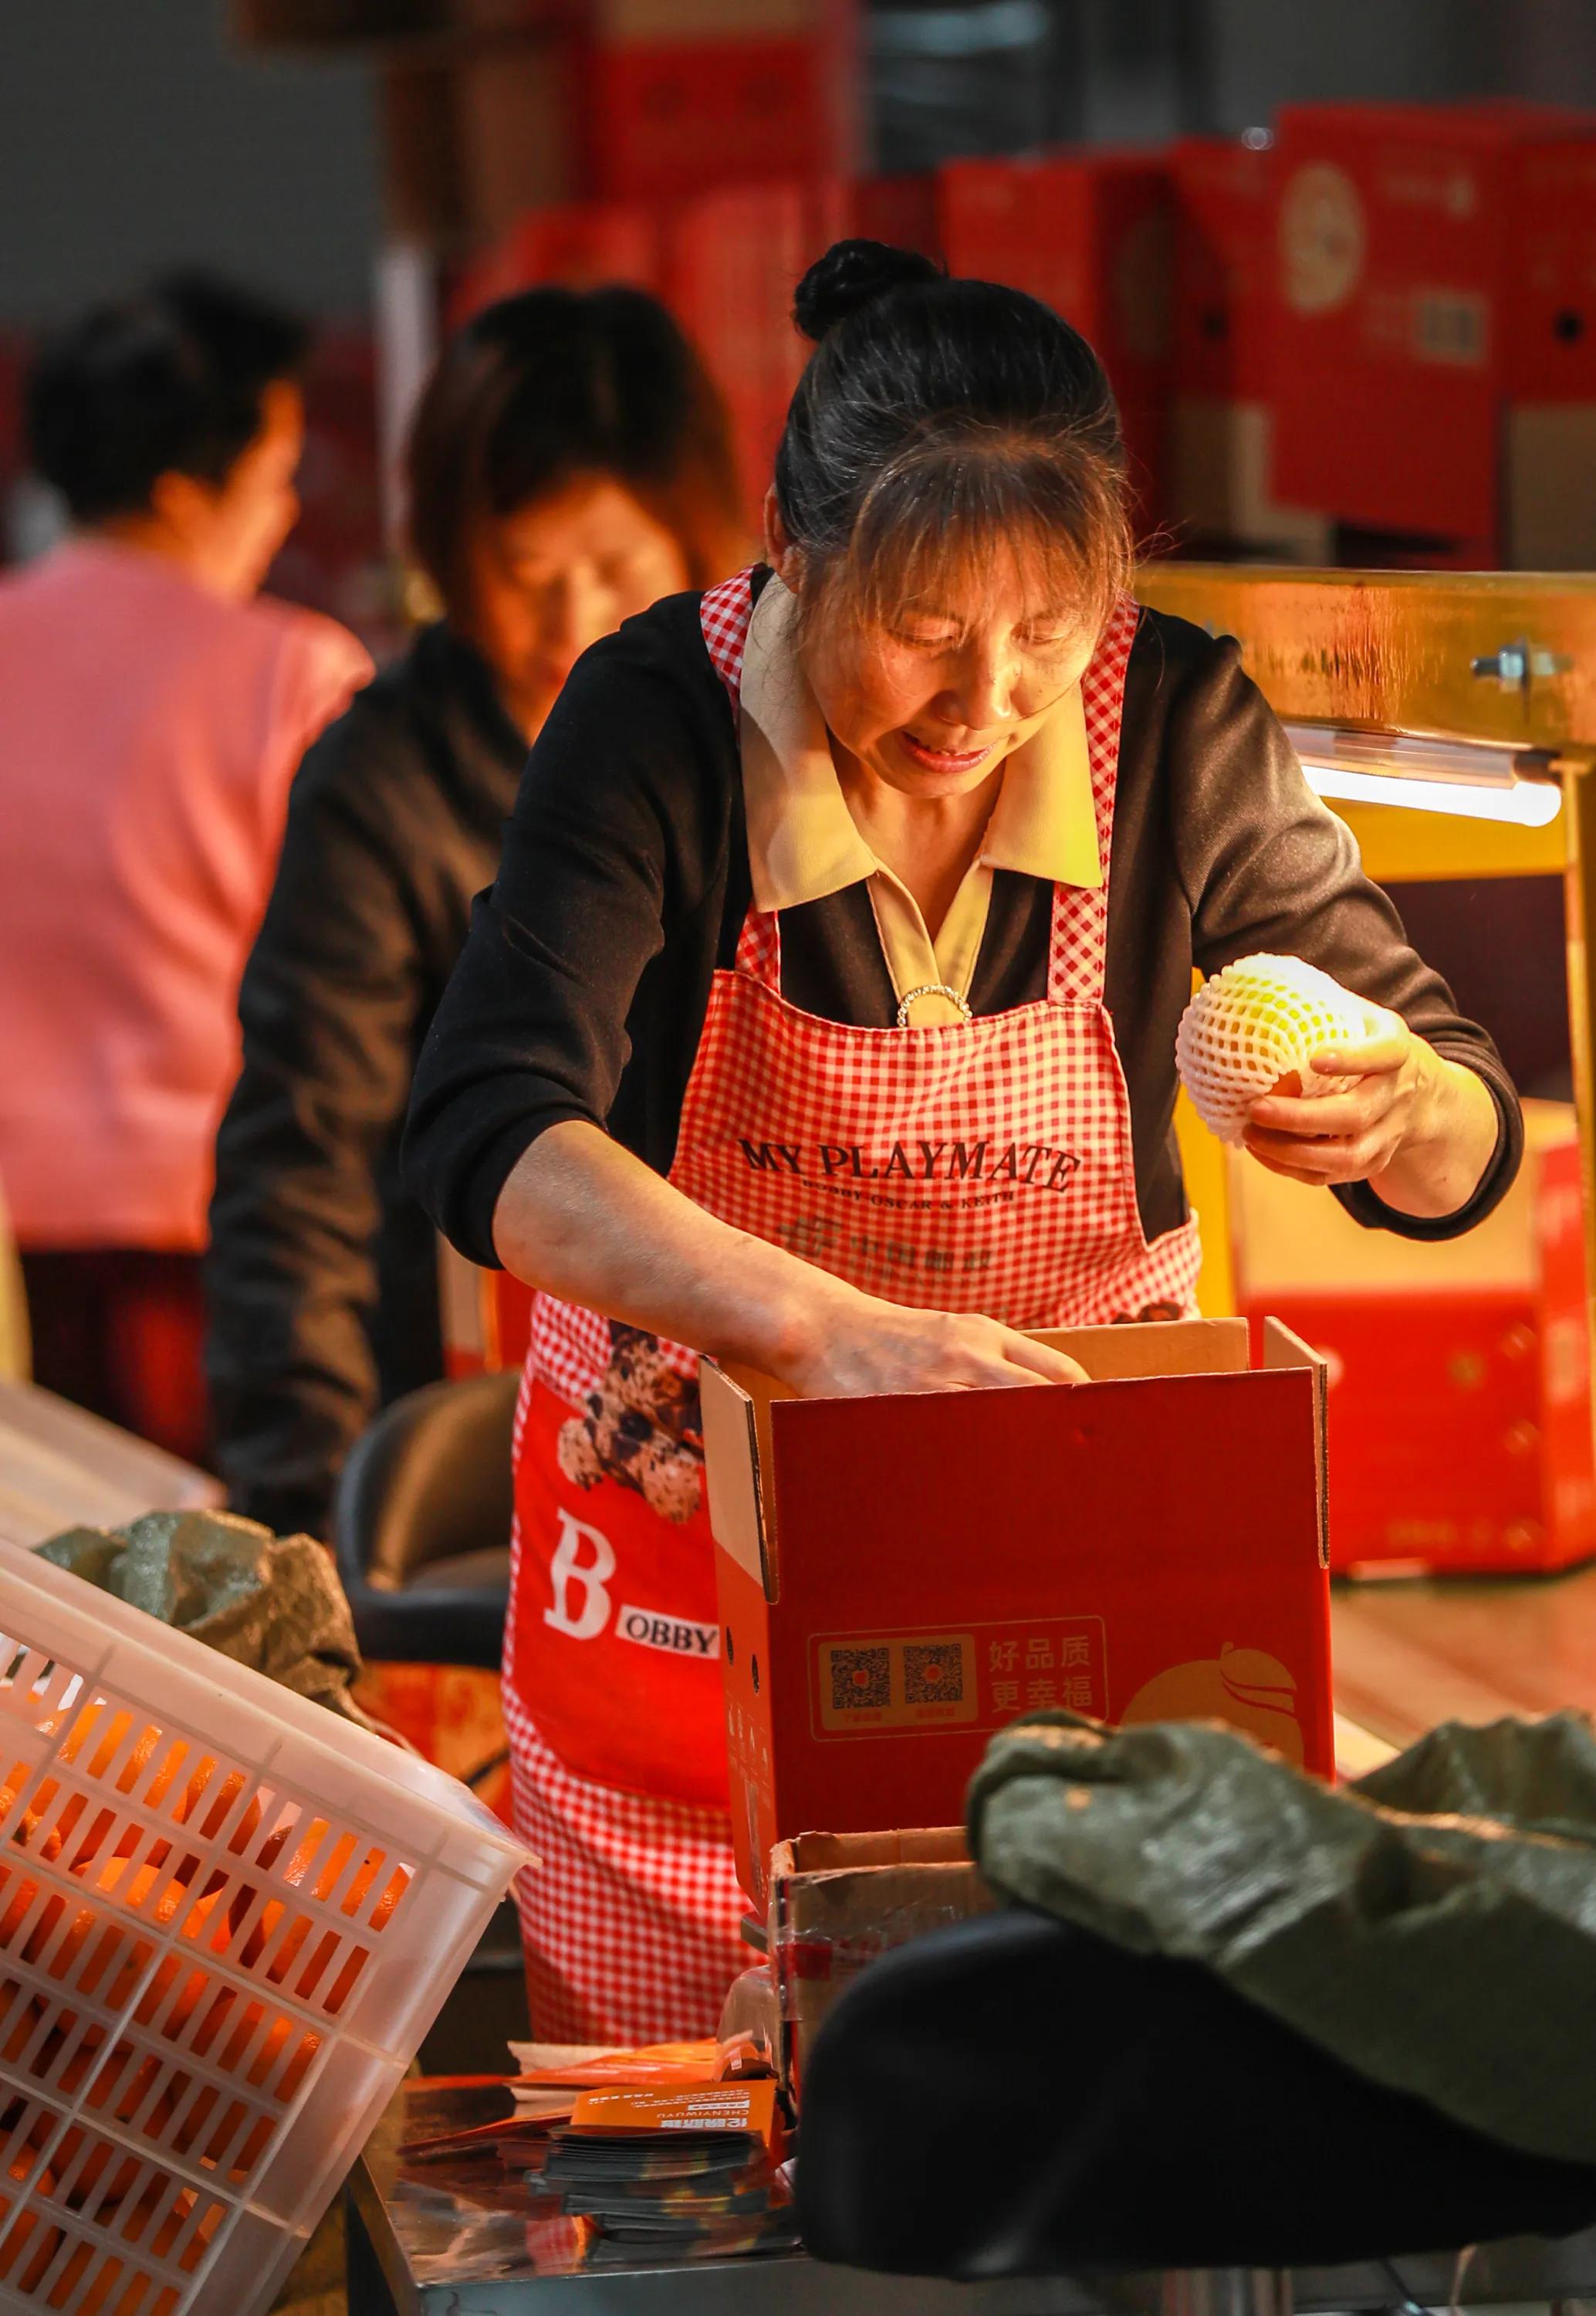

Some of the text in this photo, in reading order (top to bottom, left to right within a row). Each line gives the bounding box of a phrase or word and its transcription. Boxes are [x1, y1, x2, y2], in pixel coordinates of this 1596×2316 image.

[737, 1139, 1081, 1193] MY PLAYMATE
[870, 1194, 932, 1210] OSCAR
[940, 1199, 953, 1209] &
[961, 1190, 1015, 1209] KEITH
[988, 1634, 1091, 1674] 好品质
[990, 1675, 1093, 1715] 更幸福
